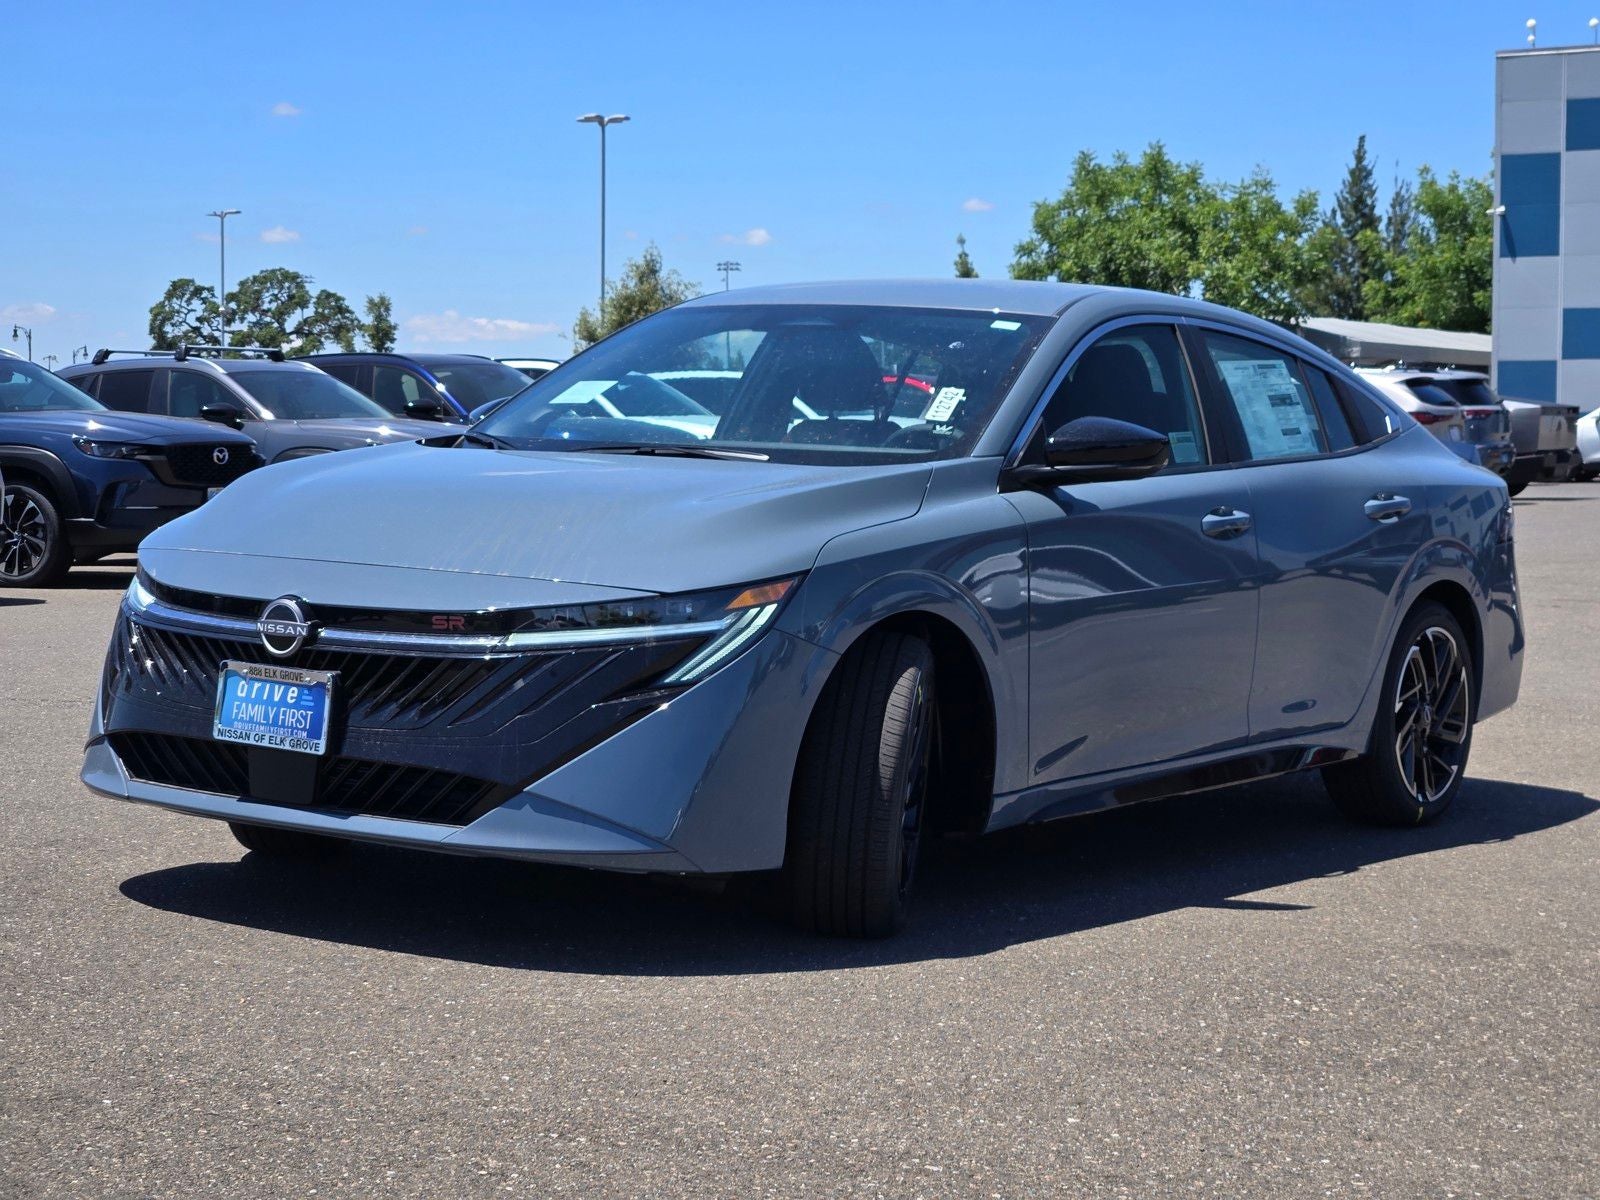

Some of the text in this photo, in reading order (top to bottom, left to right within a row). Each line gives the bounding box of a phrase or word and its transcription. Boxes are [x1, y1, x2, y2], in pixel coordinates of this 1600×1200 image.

[256, 622, 308, 637] NISSAN
[431, 615, 465, 631] SR
[264, 668, 278, 679] ELK
[280, 670, 304, 682] GROVE
[237, 680, 299, 704] drive
[232, 701, 314, 730] FAMILY FIRST
[217, 727, 321, 752] NISSAN OF ELK GROVE
